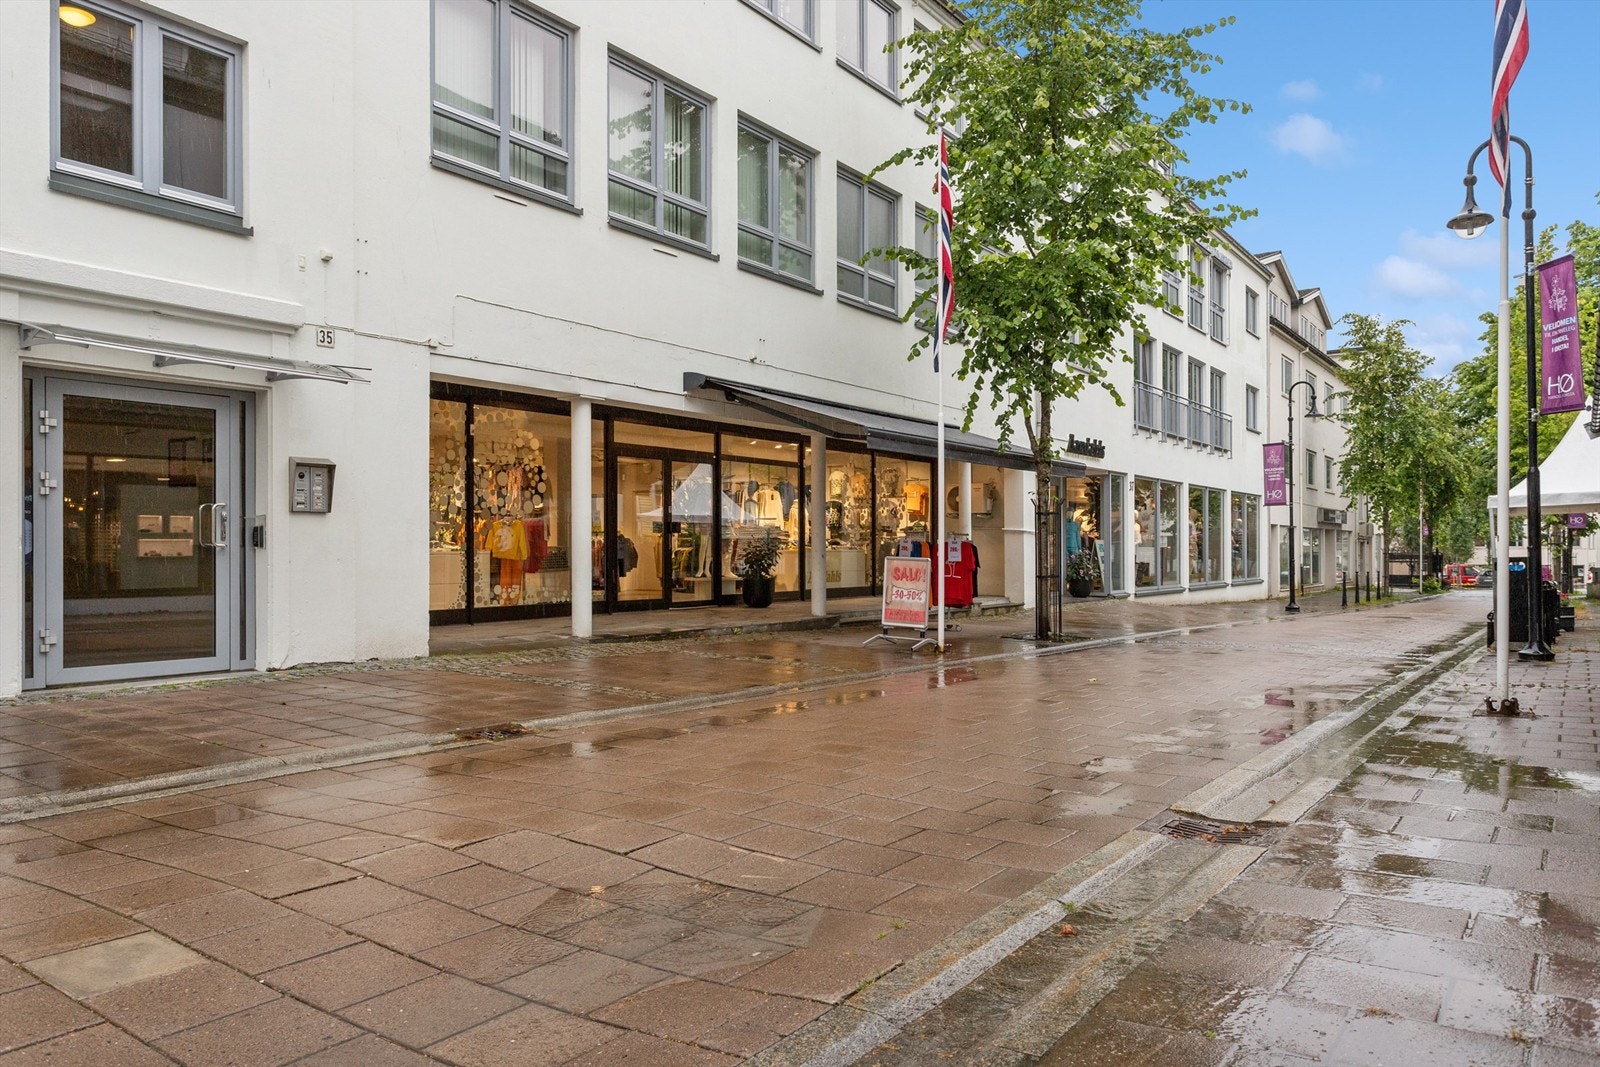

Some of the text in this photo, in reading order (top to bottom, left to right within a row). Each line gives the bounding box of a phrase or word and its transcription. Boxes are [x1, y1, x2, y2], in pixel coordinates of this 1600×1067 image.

[319, 330, 333, 345] 35
[1547, 373, 1574, 396] HØ
[1267, 490, 1282, 498] HØ
